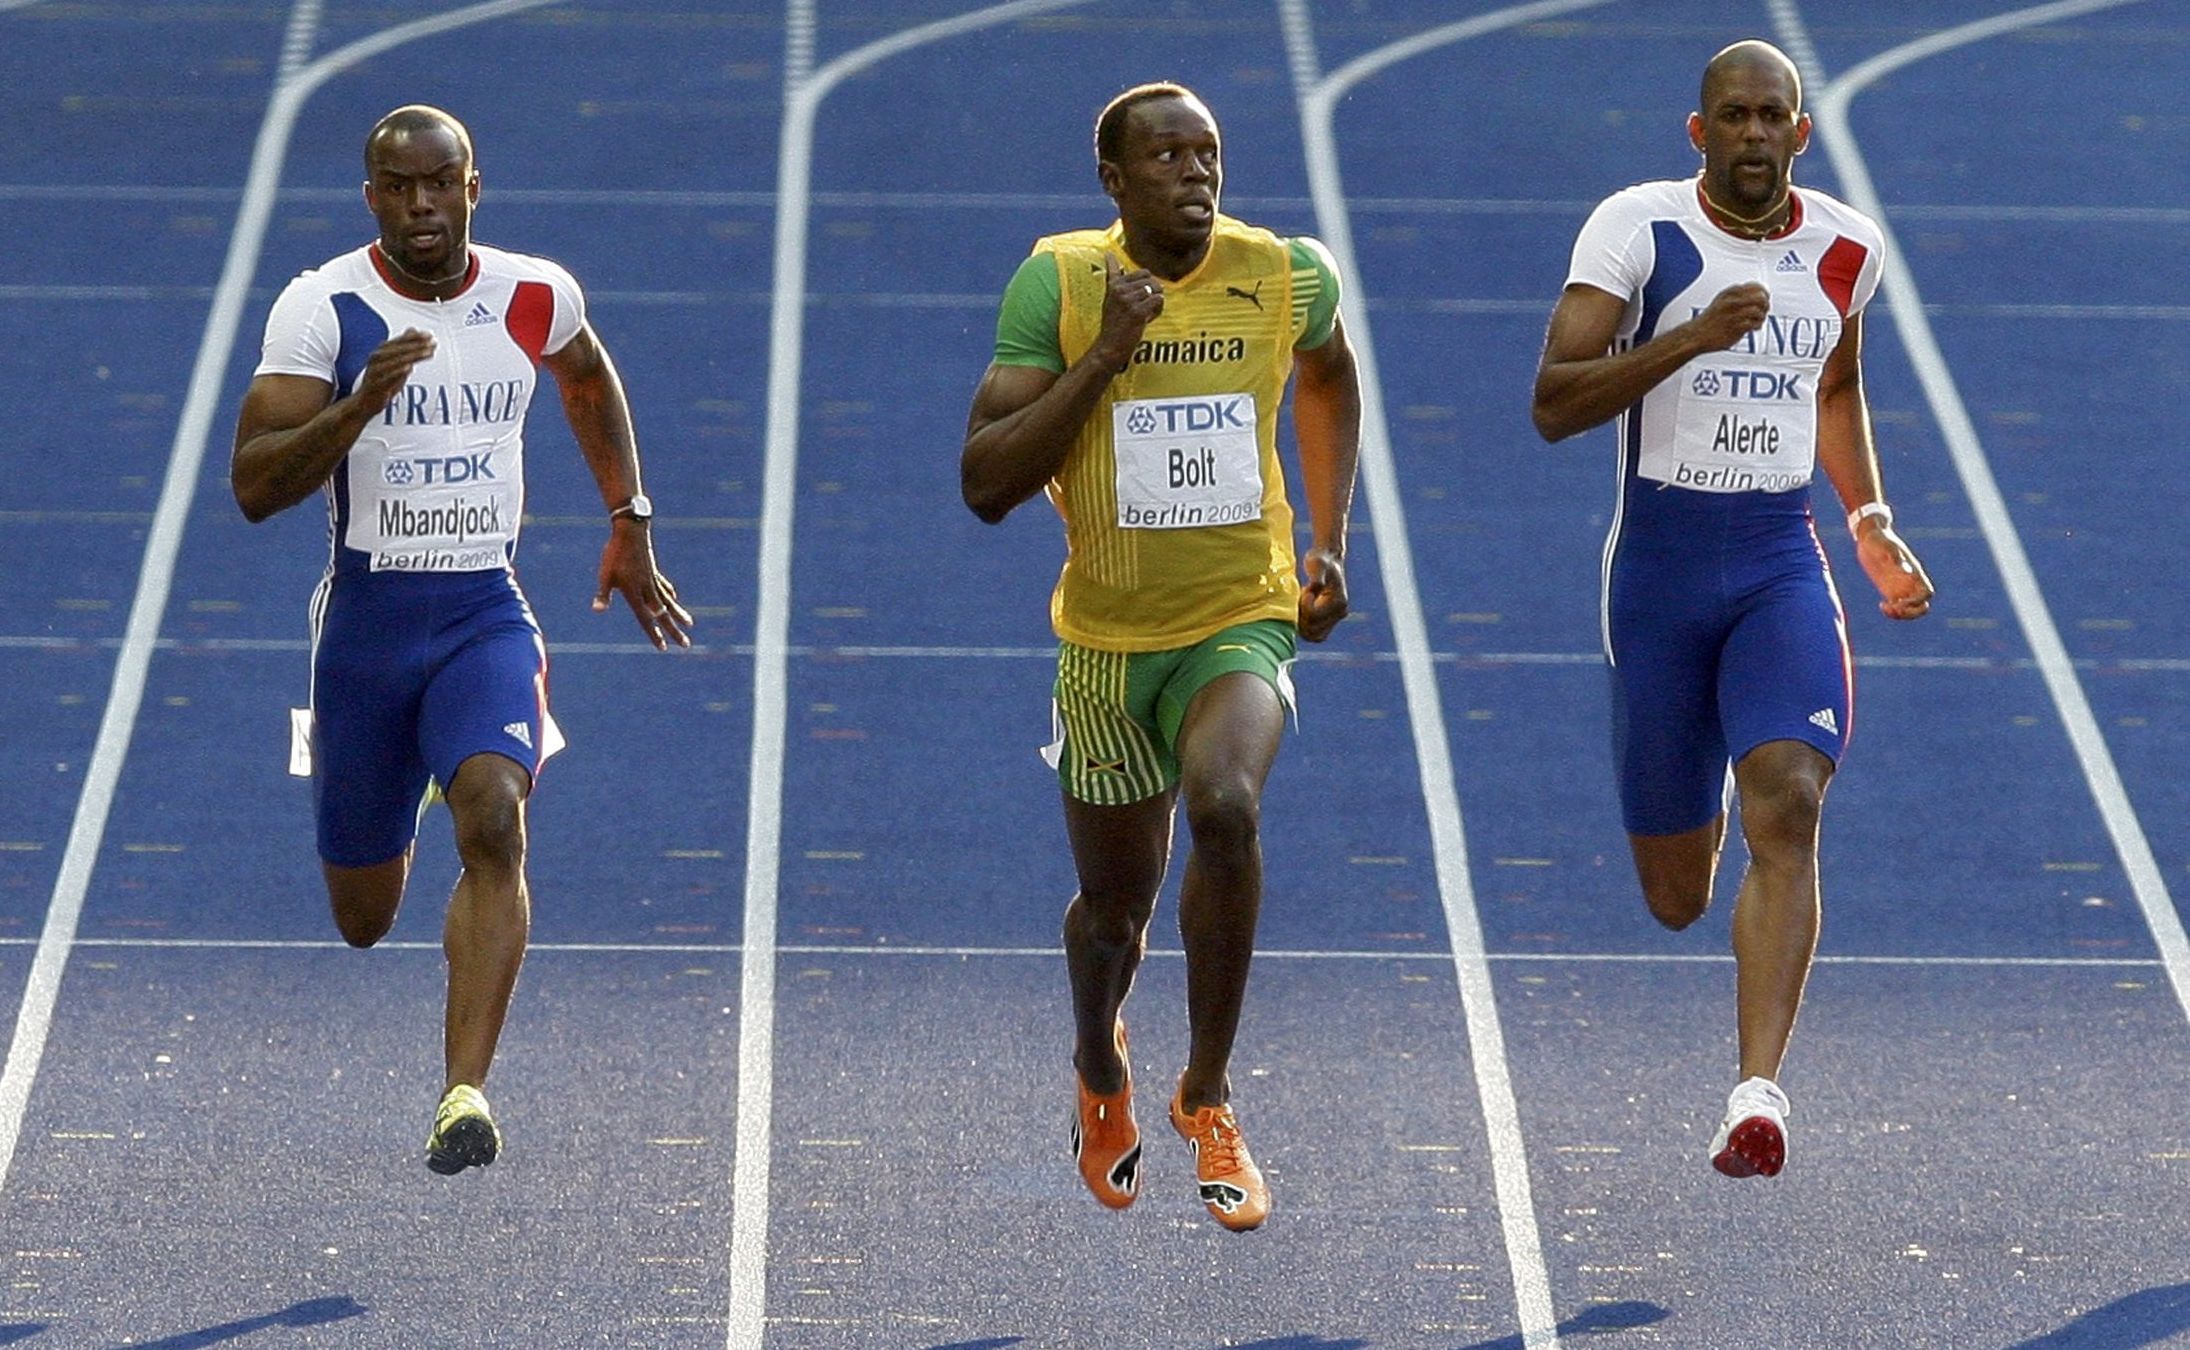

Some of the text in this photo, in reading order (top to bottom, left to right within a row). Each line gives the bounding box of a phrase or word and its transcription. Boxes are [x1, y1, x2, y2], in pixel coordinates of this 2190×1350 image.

[1118, 330, 1245, 374] amaica
[1721, 370, 1801, 400] TDK
[1155, 400, 1243, 432] TDK
[1713, 413, 1780, 455] Alerte
[414, 452, 496, 484] TDK
[1169, 447, 1216, 489] Bolt
[1675, 462, 1753, 489] berlin
[379, 494, 500, 543] Mbandjock
[1125, 502, 1253, 525] berlin 2009
[377, 550, 498, 569] berlin 2009
